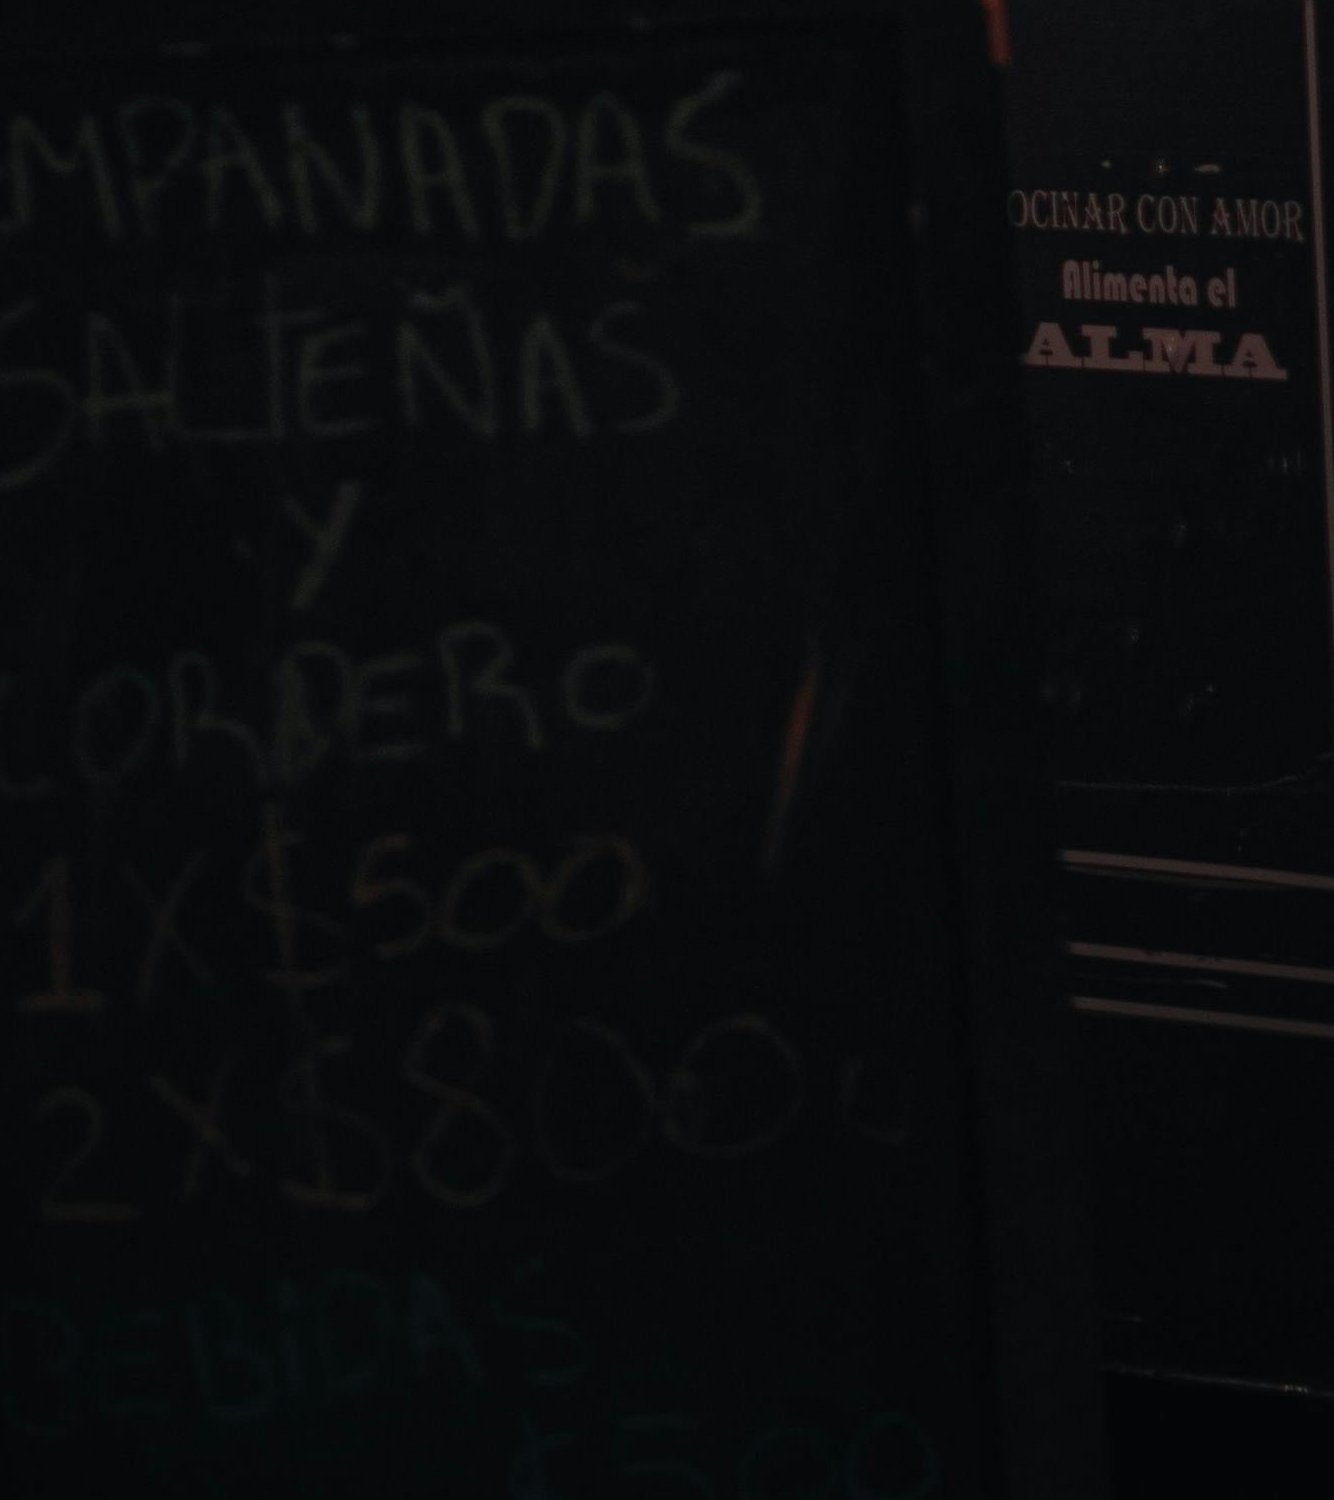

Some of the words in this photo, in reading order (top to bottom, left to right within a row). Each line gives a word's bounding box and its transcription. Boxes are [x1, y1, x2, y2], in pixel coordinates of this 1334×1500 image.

[1136, 192, 1199, 235] CON
[1210, 196, 1307, 244] AMOR
[1061, 257, 1199, 306] Alimenta
[1207, 265, 1238, 309] el
[1019, 320, 1289, 382] ALMA
